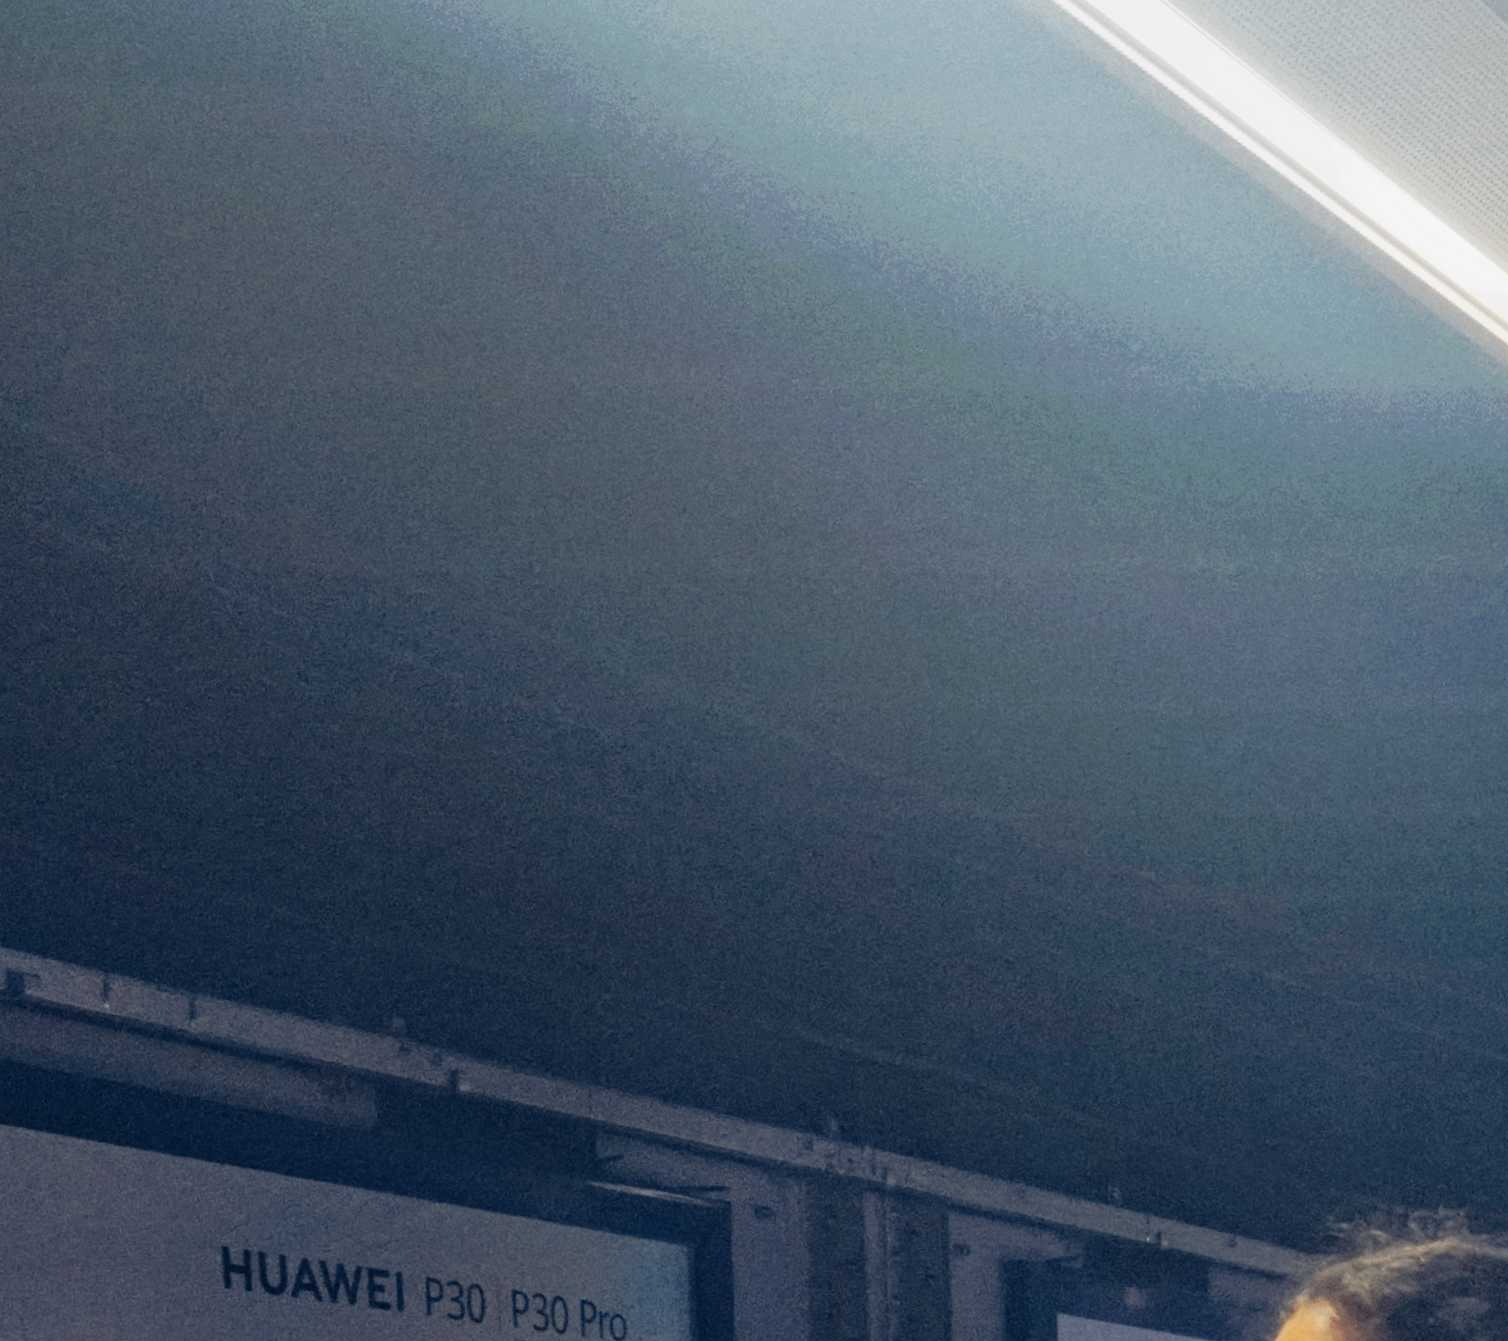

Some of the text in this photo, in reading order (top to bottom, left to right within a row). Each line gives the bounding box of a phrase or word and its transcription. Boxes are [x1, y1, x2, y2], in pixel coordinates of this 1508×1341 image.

[221, 1246, 628, 1341] HUAWEI P30 P30 Pro
